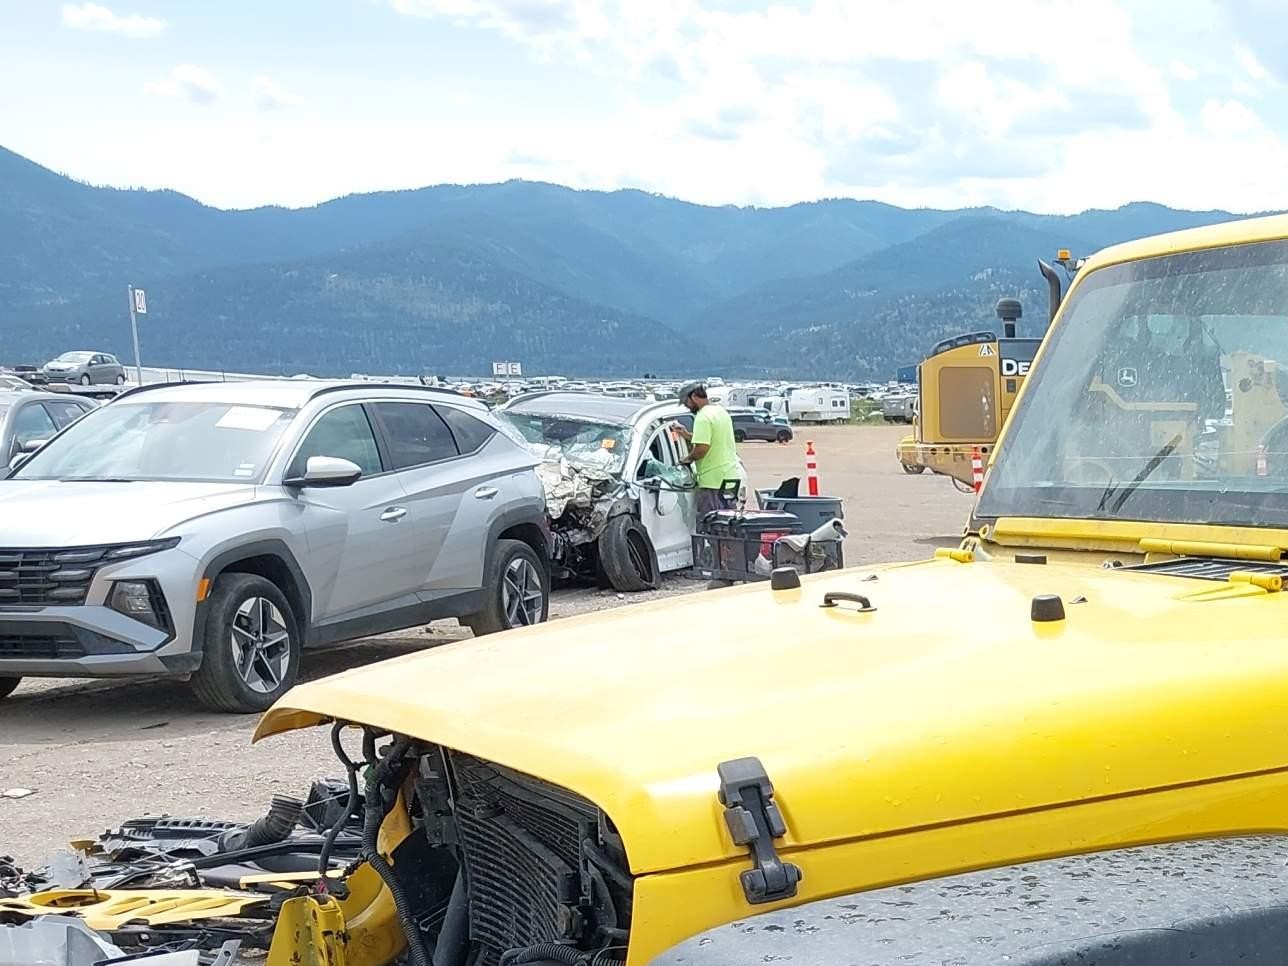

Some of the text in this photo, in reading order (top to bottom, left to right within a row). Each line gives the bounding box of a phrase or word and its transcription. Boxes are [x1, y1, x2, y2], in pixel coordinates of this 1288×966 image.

[496, 363, 503, 374] F
[511, 363, 518, 374] E
[1002, 359, 1031, 375] DE
